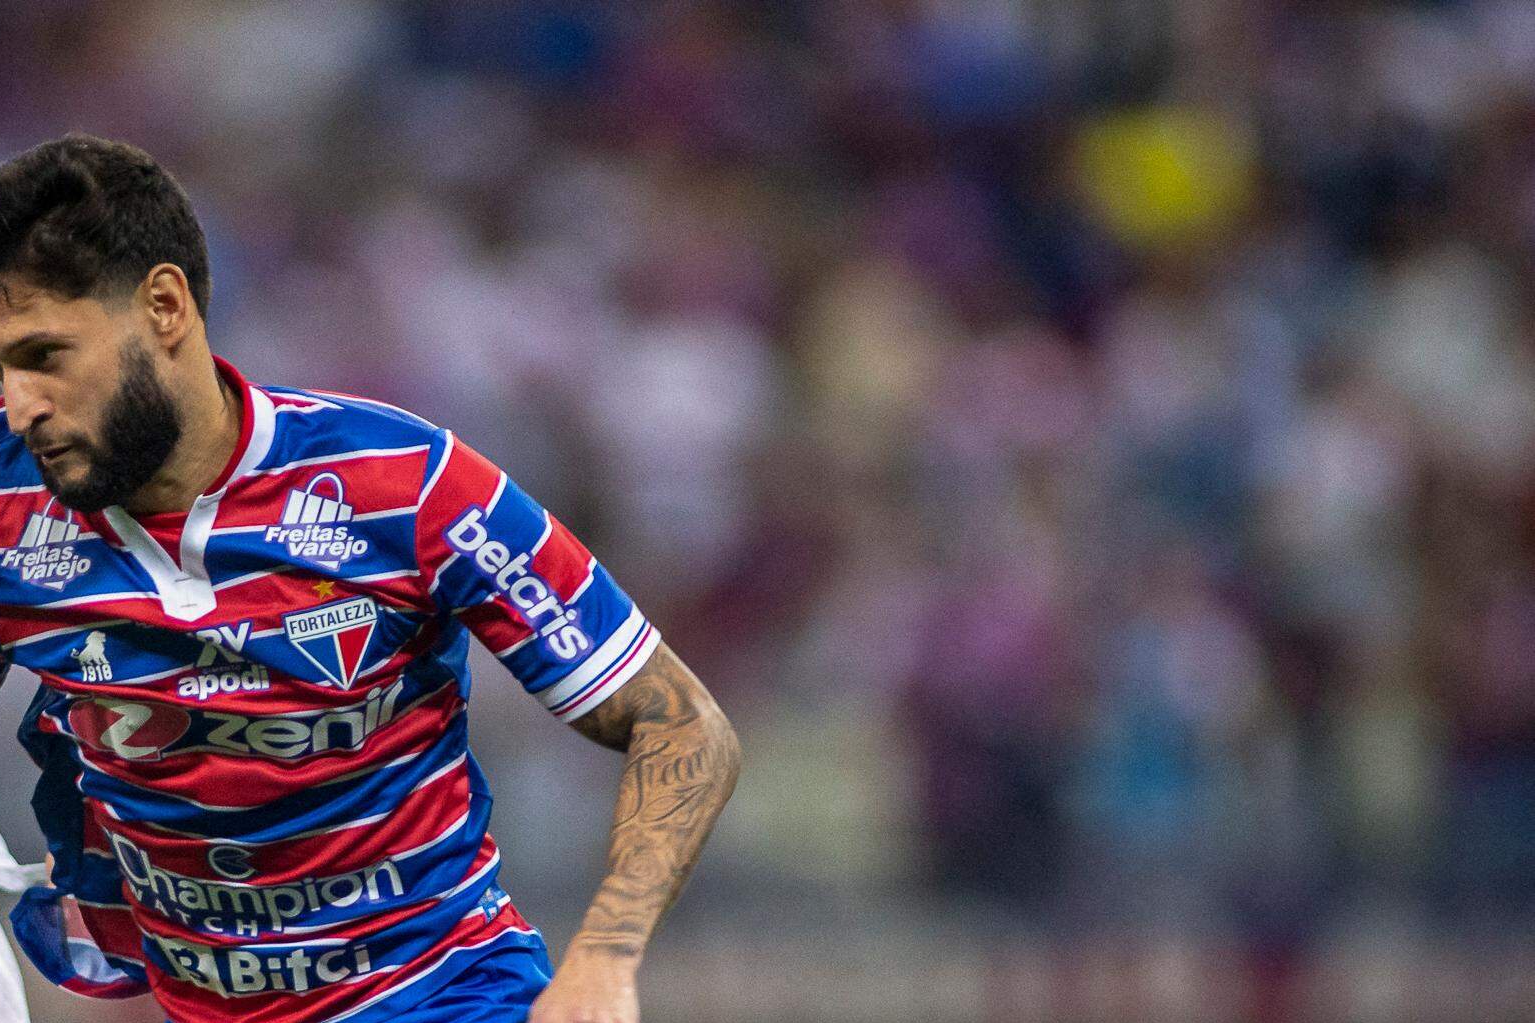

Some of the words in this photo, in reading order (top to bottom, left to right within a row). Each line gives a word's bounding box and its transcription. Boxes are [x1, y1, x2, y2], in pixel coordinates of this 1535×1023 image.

[289, 535, 369, 561] varejo
[21, 553, 92, 580] varejo
[447, 508, 590, 660] betcris
[289, 602, 375, 636] FORTALEZA
[81, 664, 114, 683] 1918
[177, 663, 271, 700] apodi
[112, 833, 404, 933] Champion
[228, 944, 372, 993] Bitci
